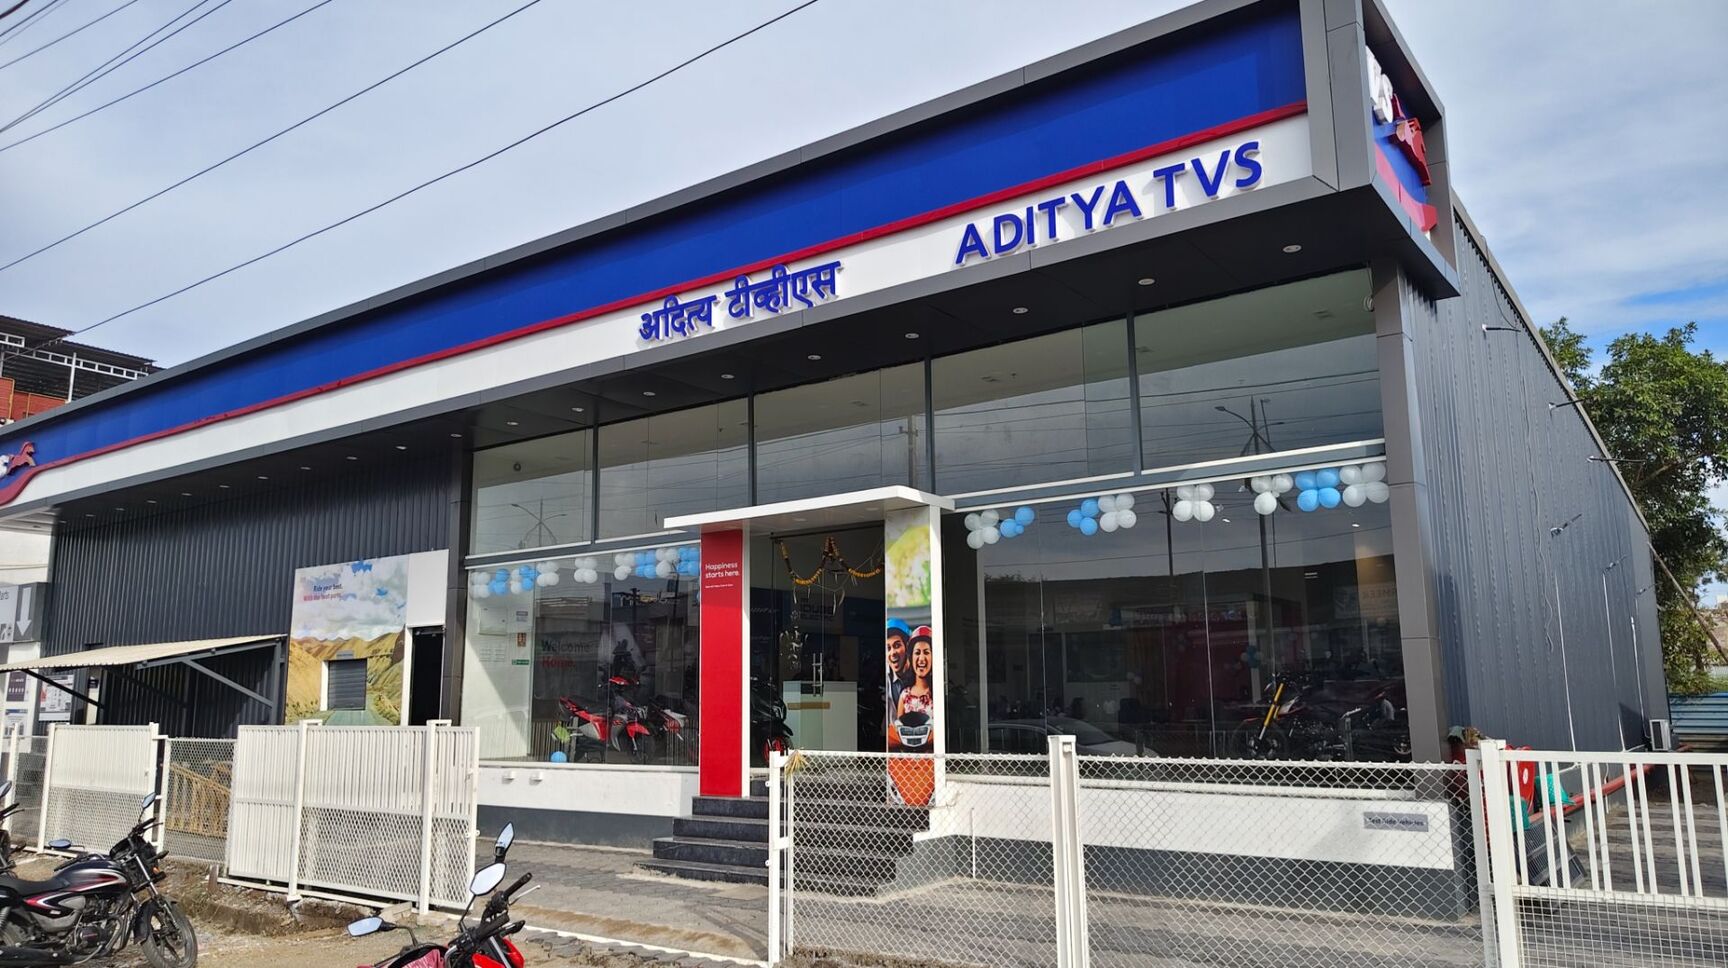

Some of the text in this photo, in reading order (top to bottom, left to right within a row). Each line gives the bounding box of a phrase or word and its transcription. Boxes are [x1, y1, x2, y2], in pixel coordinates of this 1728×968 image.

[955, 141, 1263, 266] ADITYA TVS
[639, 261, 841, 341] अदित्य टीव्हीएस
[705, 562, 738, 571] Happiness
[705, 571, 724, 579] starts
[541, 639, 591, 653] Welcome
